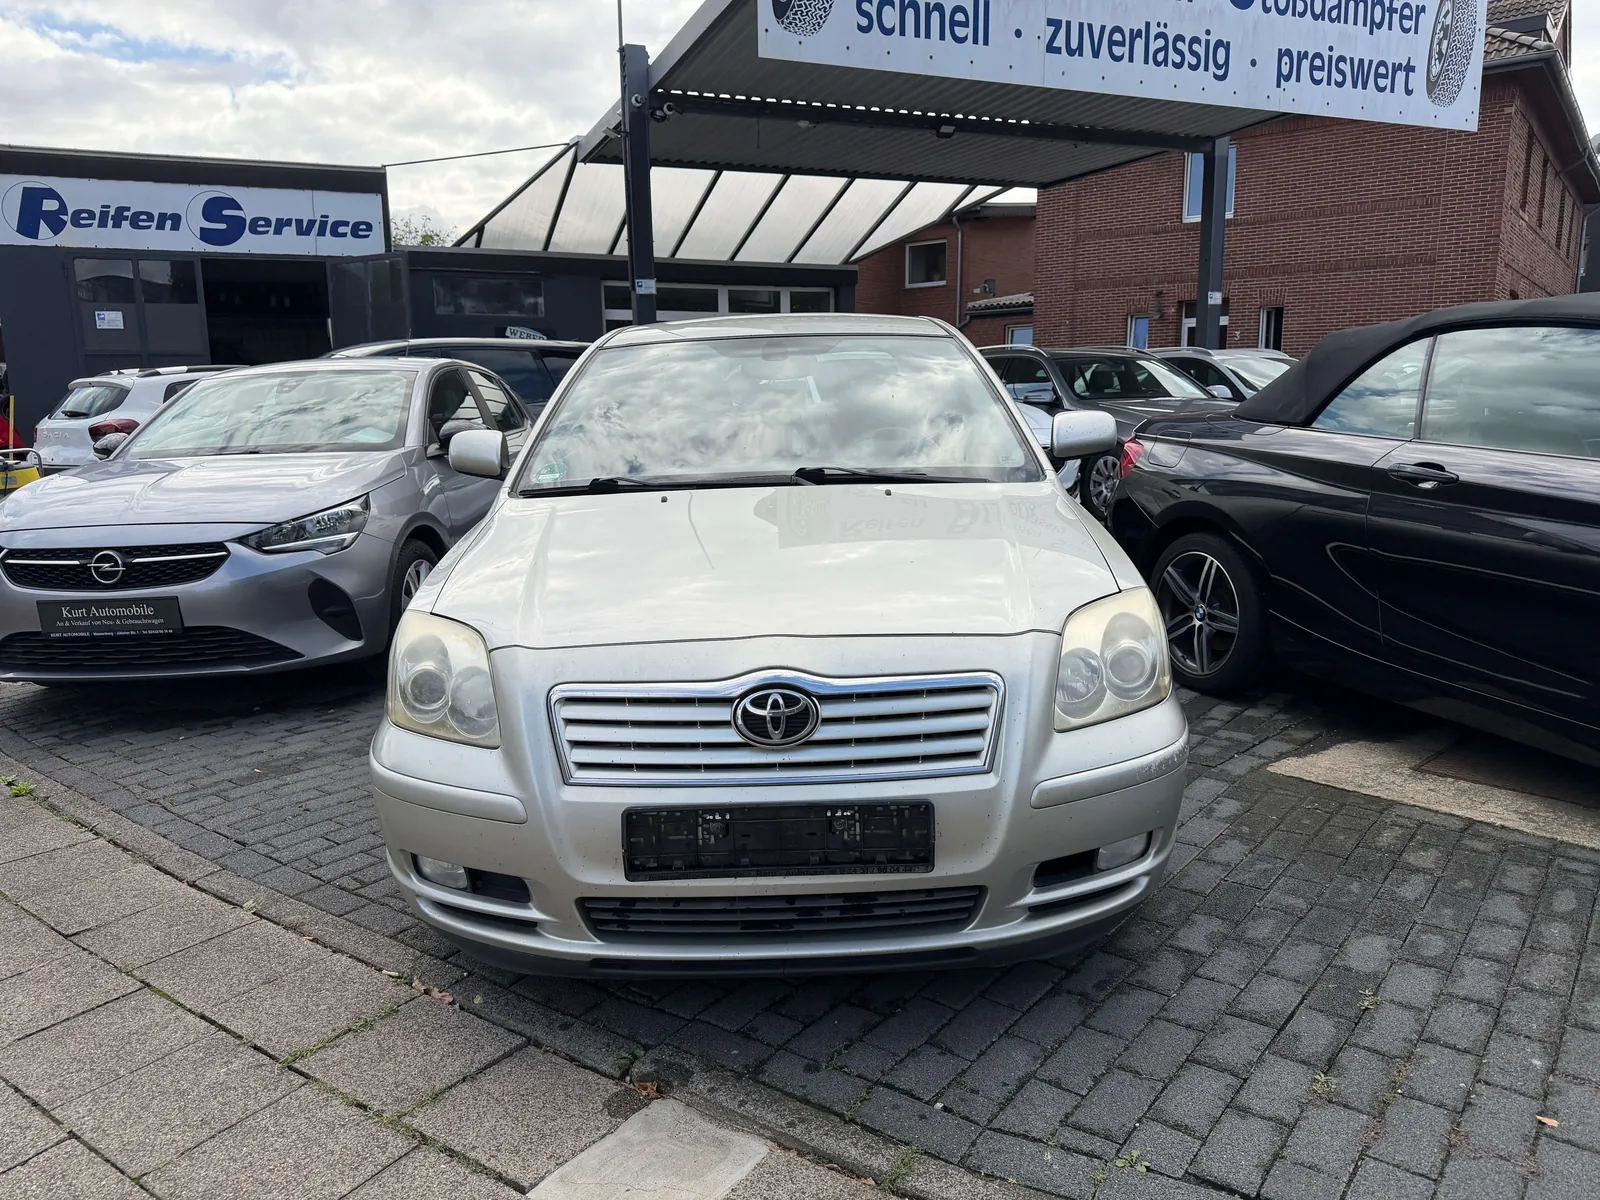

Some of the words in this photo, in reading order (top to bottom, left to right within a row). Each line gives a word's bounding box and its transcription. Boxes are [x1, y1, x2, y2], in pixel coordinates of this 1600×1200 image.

[856, 0, 990, 46] schnell
[1046, 17, 1231, 81] zuverlässig
[1276, 45, 1416, 96] preiswert
[16, 187, 182, 240] Reifen
[200, 196, 373, 246] Service
[1234, 331, 1240, 341] 3
[61, 606, 87, 618] Kurt
[90, 604, 154, 617] Automobile
[71, 619, 91, 627] Verkauf
[122, 617, 165, 626] Gebrauchtwagen
